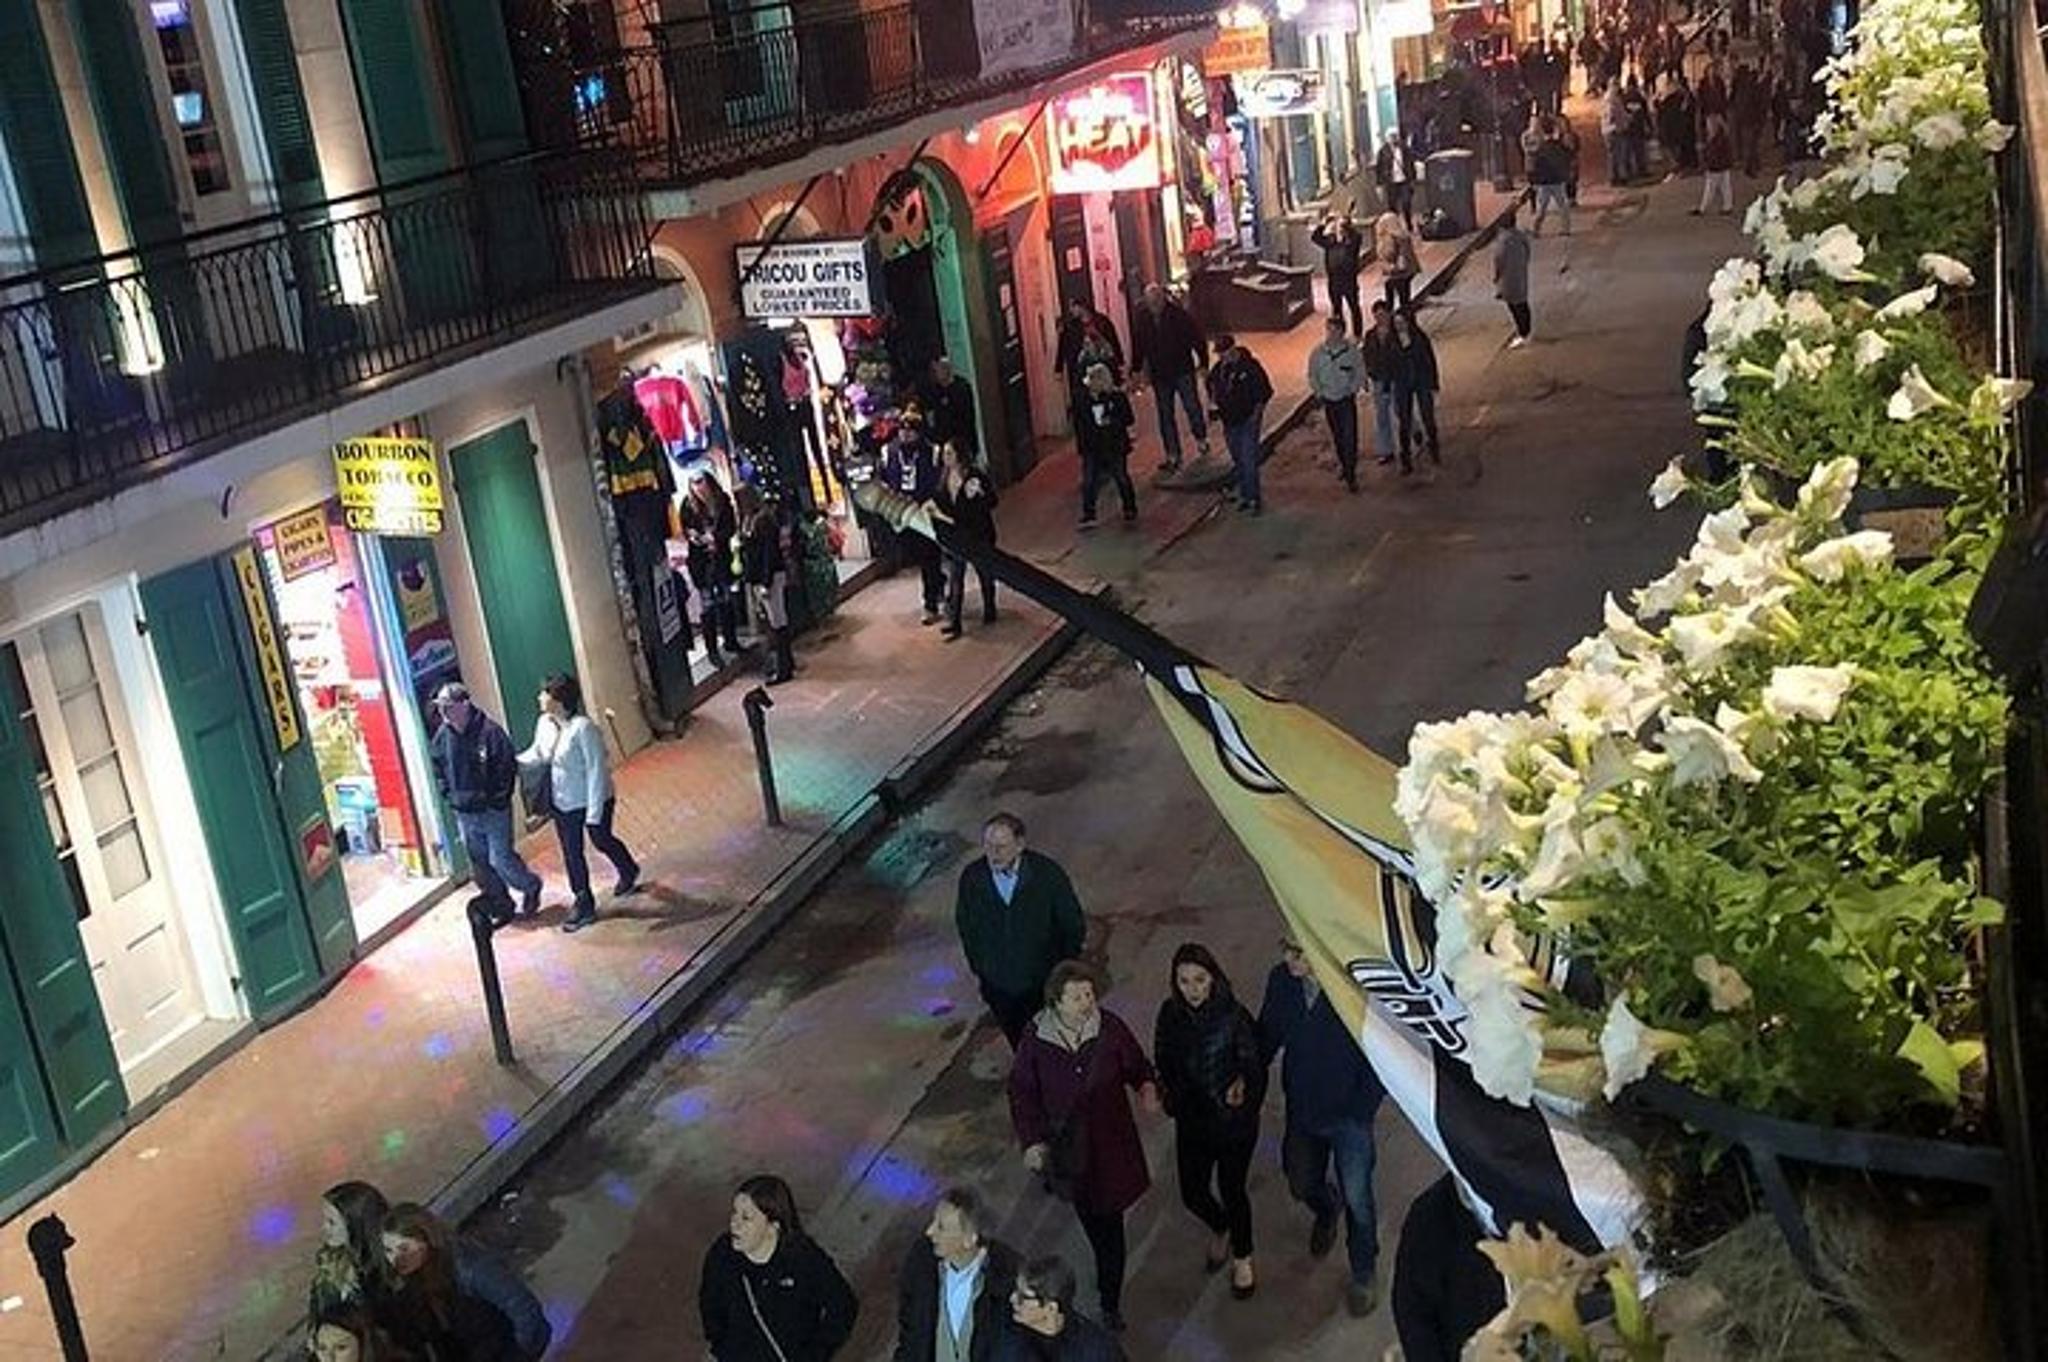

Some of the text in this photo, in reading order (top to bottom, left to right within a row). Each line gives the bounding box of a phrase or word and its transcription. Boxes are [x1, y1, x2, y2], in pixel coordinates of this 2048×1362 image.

[813, 260, 864, 283] GIFTS
[760, 286, 852, 300] GUARANTEED
[753, 298, 863, 313] LOWEST PRICES
[336, 442, 432, 462] BOURBON
[244, 564, 291, 732] CIGARS
